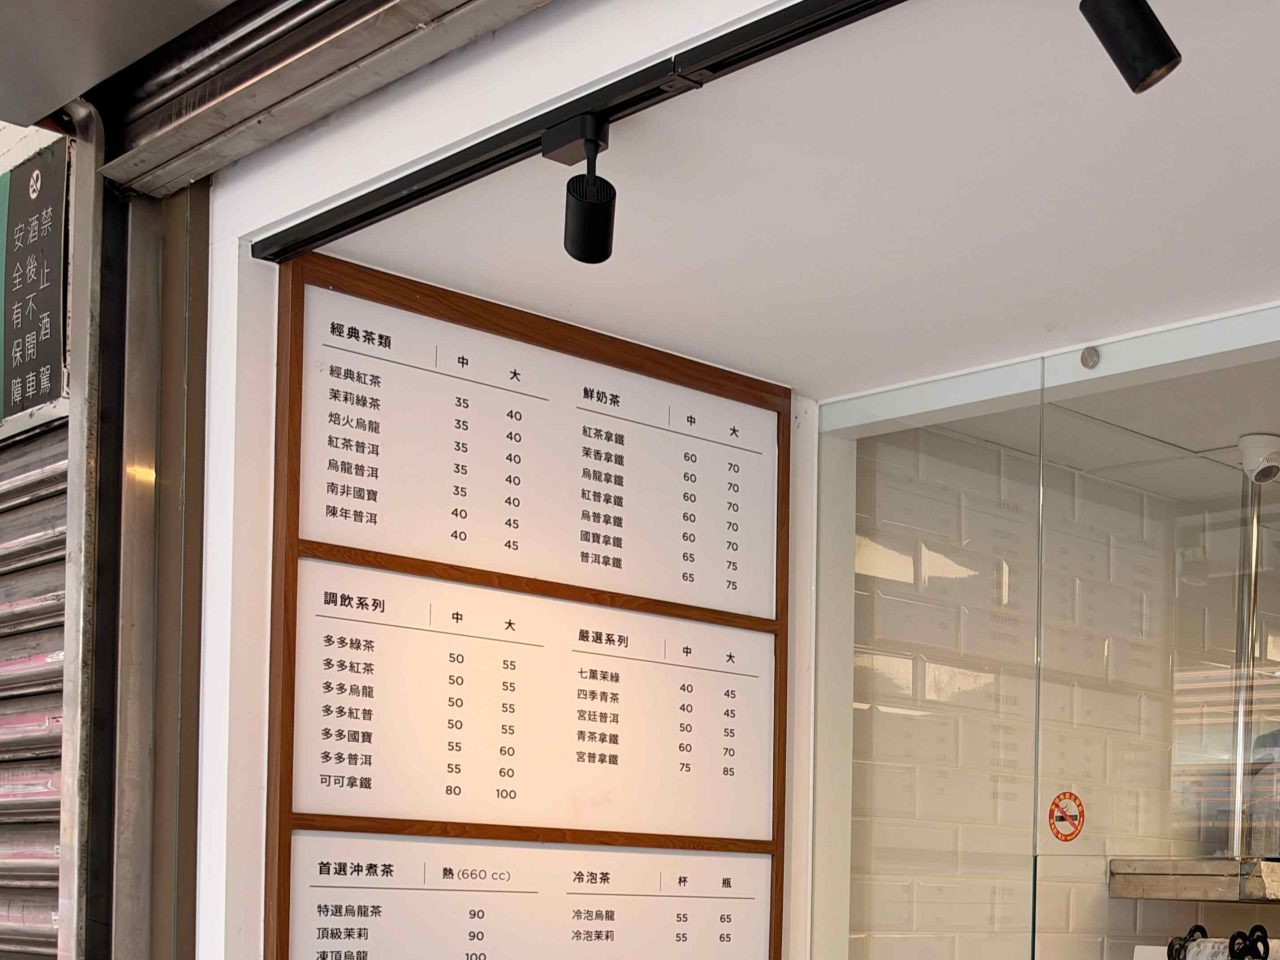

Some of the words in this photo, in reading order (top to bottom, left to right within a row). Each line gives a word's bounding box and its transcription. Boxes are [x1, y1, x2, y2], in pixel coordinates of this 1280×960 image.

[11, 223, 25, 406] 安全有保障
[25, 214, 40, 398] 酒後不開車
[39, 206, 53, 396] 禁止酒駕
[330, 322, 391, 349] 經典茶類
[458, 356, 468, 368] 中
[510, 369, 521, 382] 大
[329, 365, 381, 387] 經典紅茶
[455, 397, 469, 409] 35
[329, 388, 381, 410] 茉莉綠茶
[454, 419, 469, 431] 35
[583, 387, 620, 407] 鮮奶茶
[687, 415, 695, 426] 中
[730, 426, 739, 438] 大
[328, 412, 380, 434] 焙火烏龍
[454, 441, 468, 453] 35
[582, 425, 625, 446] 紅茶拿鐵
[684, 453, 697, 463] 60
[328, 435, 379, 457] 紅茶普洱
[454, 464, 468, 475] 35
[582, 447, 624, 467] 茉香拿鐵
[684, 473, 696, 483] 60
[327, 459, 378, 479] 烏龍普洱
[453, 486, 467, 497] 35
[582, 468, 624, 487] 烏龍拿鐵
[683, 493, 696, 503] 60
[326, 482, 378, 502] 南非國寶
[451, 508, 467, 519] 40
[581, 488, 623, 507] 紅普拿鐵
[683, 513, 696, 523] 60
[326, 505, 377, 525] 陳年普洱
[451, 531, 467, 541] 40
[581, 509, 623, 528] 烏普拿鐵
[682, 533, 695, 543] 60
[580, 530, 623, 549] 國寶拿鐵
[683, 552, 695, 563] 65
[580, 551, 622, 569] 普洱拿鐵
[682, 573, 694, 582] 65
[324, 591, 385, 613] 調飲系列
[452, 611, 463, 623] 中
[504, 619, 515, 632] 大
[323, 635, 375, 652] 多多綠茶
[449, 653, 464, 663] 50
[503, 660, 516, 671] 55
[578, 629, 628, 648] 嚴選系列
[683, 646, 692, 657] 中
[726, 653, 735, 664] 大
[323, 658, 374, 675] 多多紅茶
[448, 675, 463, 686] 50
[502, 682, 516, 692] 55
[680, 684, 693, 694] 40
[724, 689, 736, 699] 45
[322, 681, 374, 698] 多多烏龍
[448, 698, 463, 708] 50
[502, 703, 515, 714] 55
[577, 689, 620, 704] 四季青茶
[680, 704, 693, 713] 40
[724, 709, 736, 719] 45
[322, 704, 373, 721] 多多紅普
[448, 720, 463, 730] 50
[501, 725, 515, 735] 55
[577, 710, 619, 725] 宮廷普洱
[680, 723, 692, 733] 50
[724, 728, 735, 738] 55
[321, 728, 373, 744] 多多國寶
[448, 742, 461, 752] 55
[500, 747, 515, 757] 60
[577, 730, 619, 745] 青茶拿鐵
[679, 743, 692, 753] 60
[723, 748, 735, 757] 70
[321, 751, 372, 767] 多多普洱
[447, 764, 461, 774] 55
[499, 768, 514, 778] 60
[576, 751, 618, 766] 宮普拿鐵
[680, 763, 691, 772] 75
[723, 767, 735, 777] 85
[320, 775, 372, 790] 可可拿鐵
[446, 786, 461, 796] 80
[496, 789, 516, 799] 100
[318, 861, 394, 878] 首選沖煮茶
[573, 871, 610, 885] 冷泡茶
[678, 876, 688, 887] 杯
[722, 878, 732, 889] 瓶
[317, 905, 382, 918] 特選烏龍茶
[469, 910, 485, 919] 90
[572, 910, 615, 921] 冷泡烏龍
[676, 914, 688, 922] 55
[720, 914, 732, 923] 65
[317, 928, 368, 941] 頂級茉莉
[468, 931, 484, 941] 90
[572, 931, 615, 942] 冷泡茉莉
[676, 933, 687, 942] 55
[719, 934, 731, 942] 65
